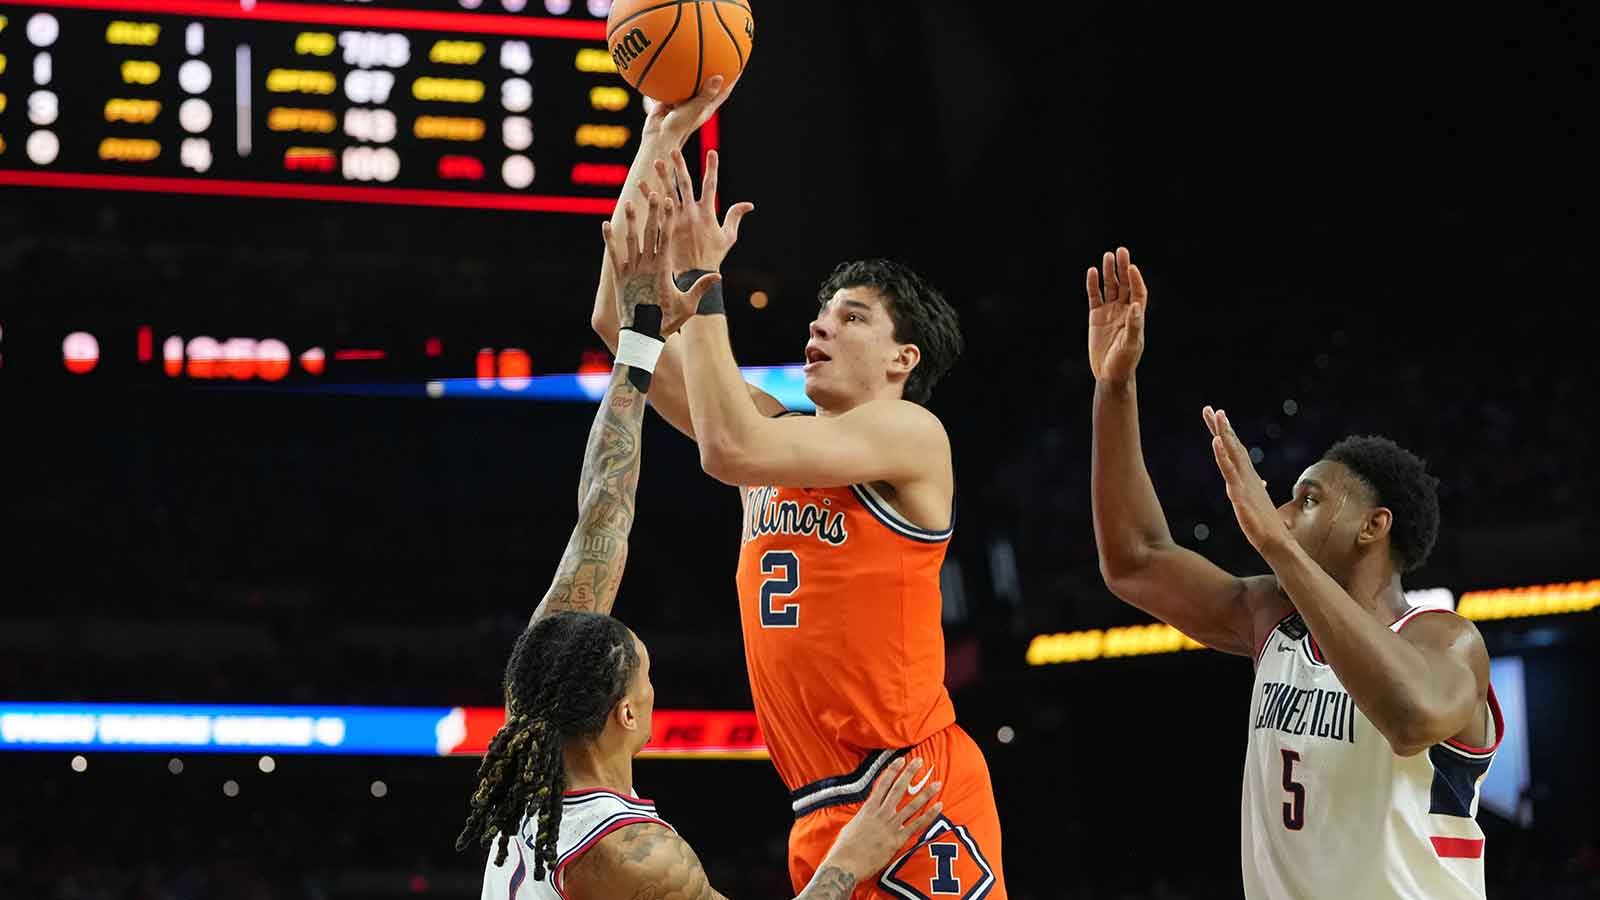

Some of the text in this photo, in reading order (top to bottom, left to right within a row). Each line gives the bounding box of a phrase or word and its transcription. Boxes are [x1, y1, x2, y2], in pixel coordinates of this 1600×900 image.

[612, 27, 651, 70] Wil
[760, 549, 800, 629] 2
[1280, 749, 1306, 832] 5
[928, 842, 961, 895] I
